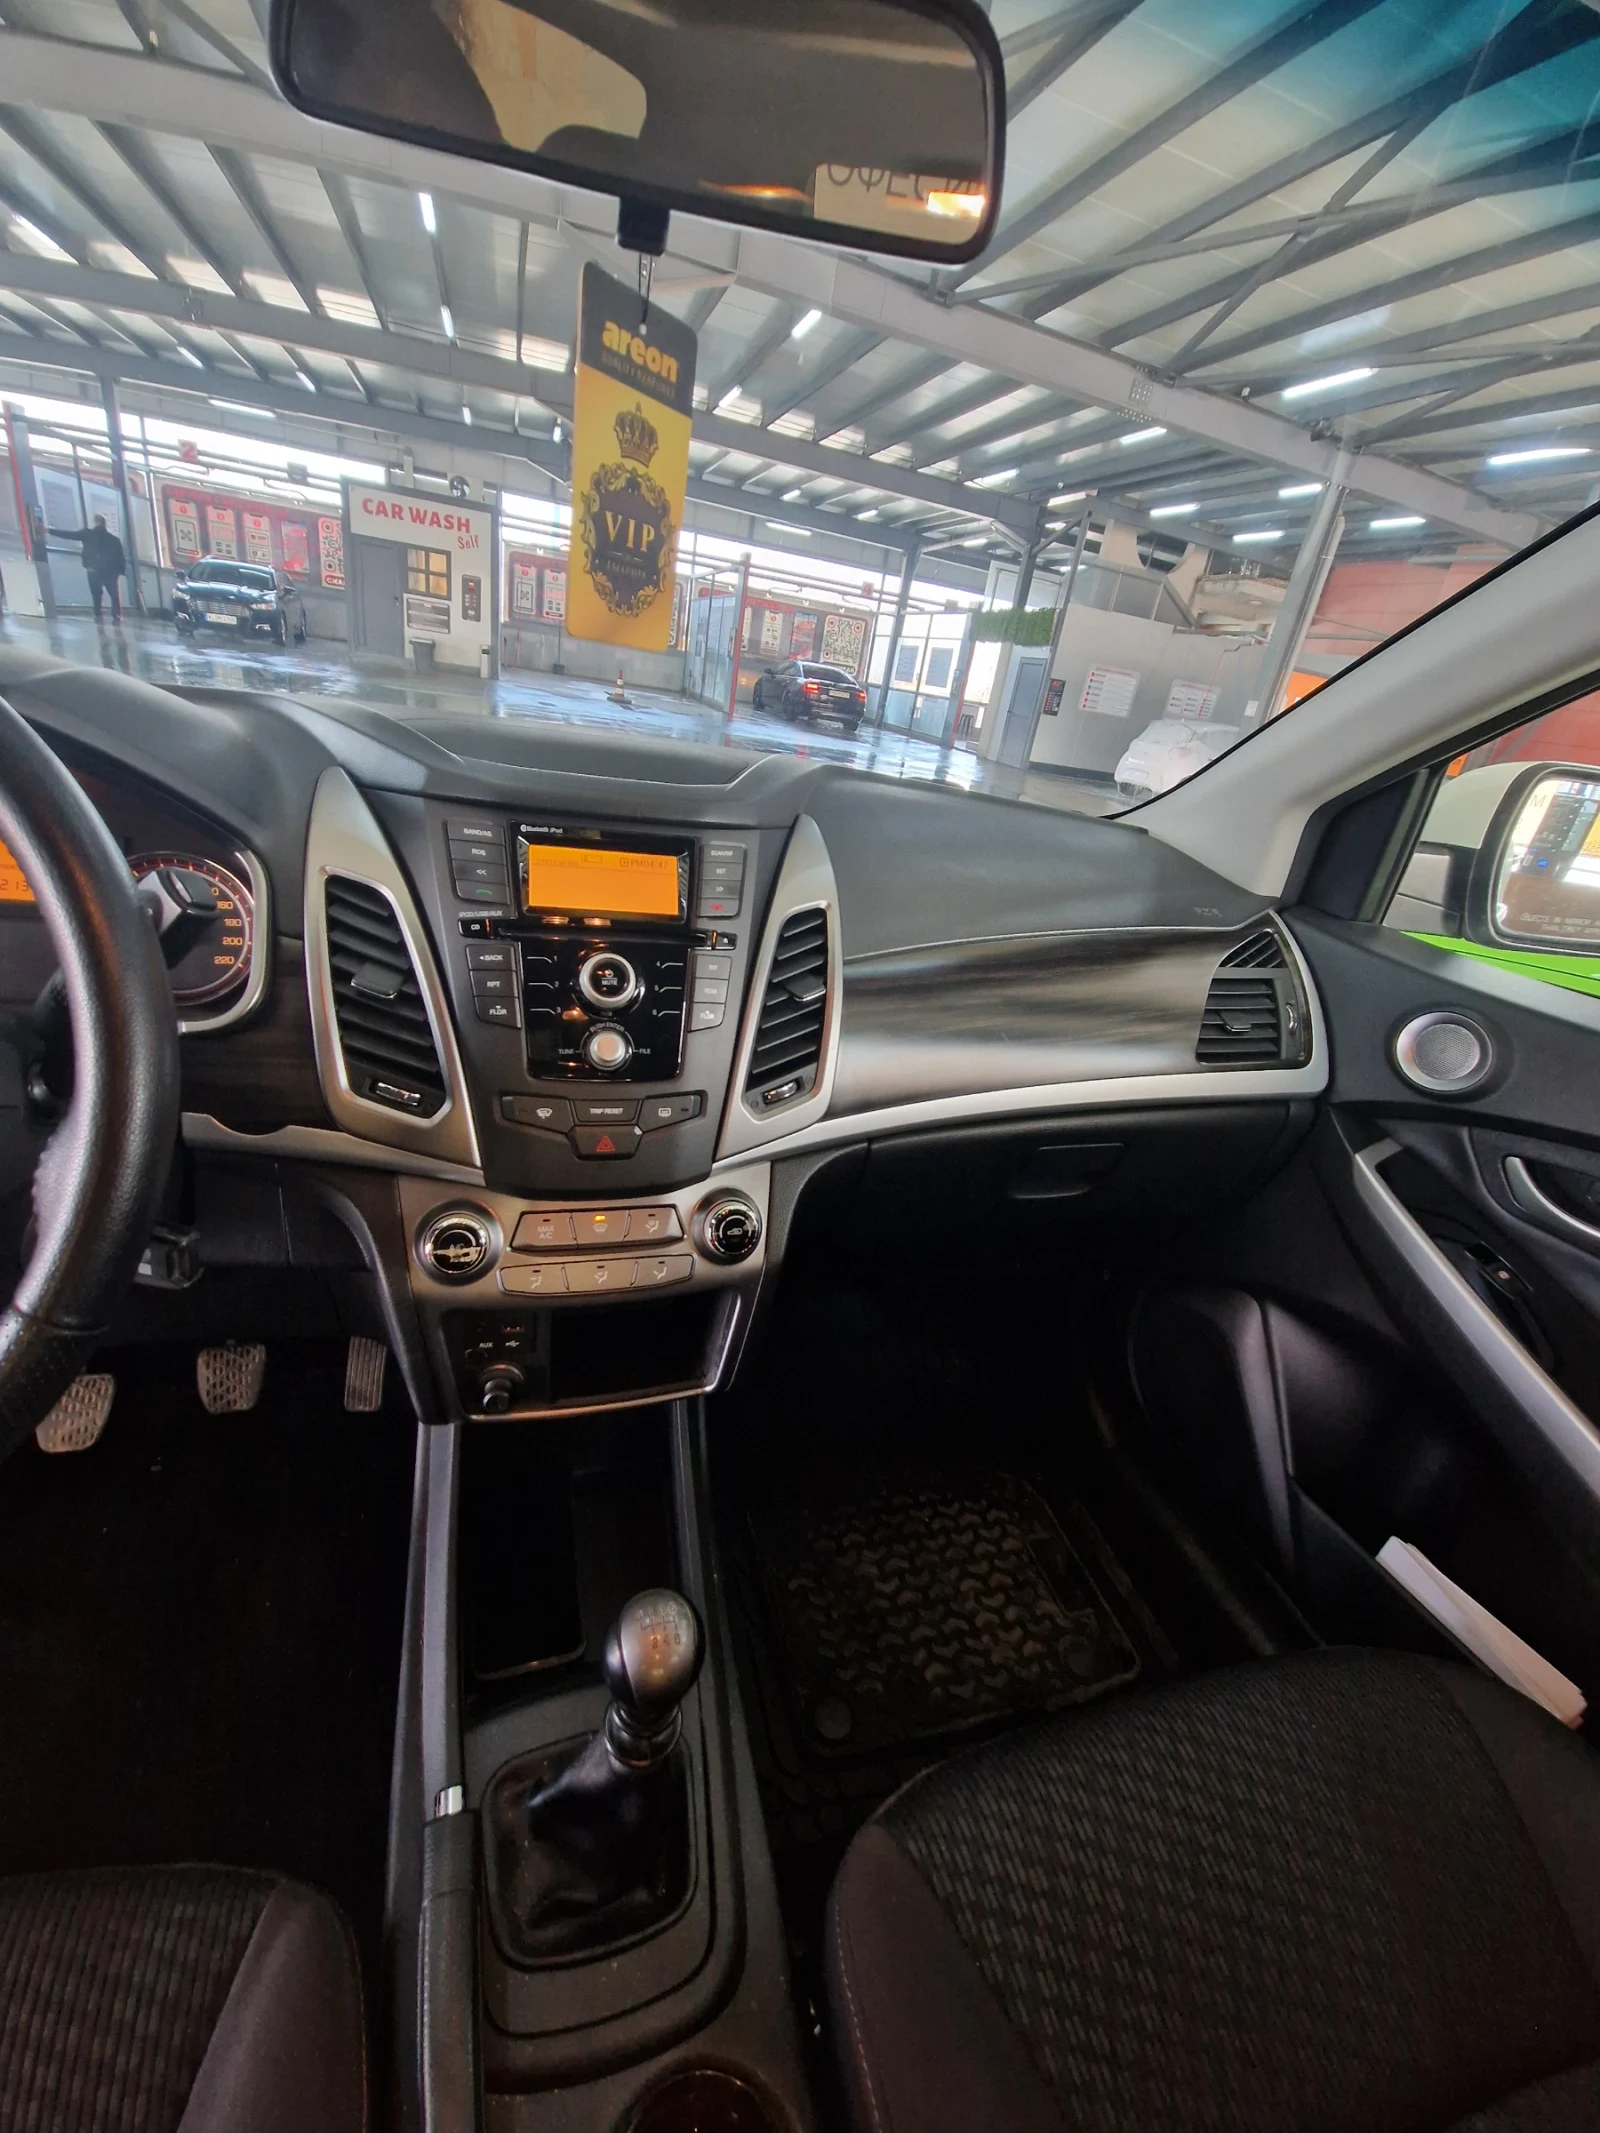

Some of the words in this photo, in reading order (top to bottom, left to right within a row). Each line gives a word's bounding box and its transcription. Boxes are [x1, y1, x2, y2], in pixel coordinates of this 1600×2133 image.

[602, 320, 679, 383] areon
[362, 497, 405, 521] CAR
[409, 507, 471, 534] WASH
[605, 510, 655, 553] VIP
[457, 534, 480, 550] Self
[471, 848, 487, 856] RDS
[216, 901, 233, 909] 160
[224, 918, 242, 927] 180
[223, 937, 242, 945] 200
[214, 955, 234, 964] 220
[486, 980, 501, 988] RPT
[606, 1021, 625, 1032] ENTER
[589, 1107, 603, 1115] TRIP
[604, 1107, 624, 1115] RESET
[539, 1232, 553, 1240] A/C
